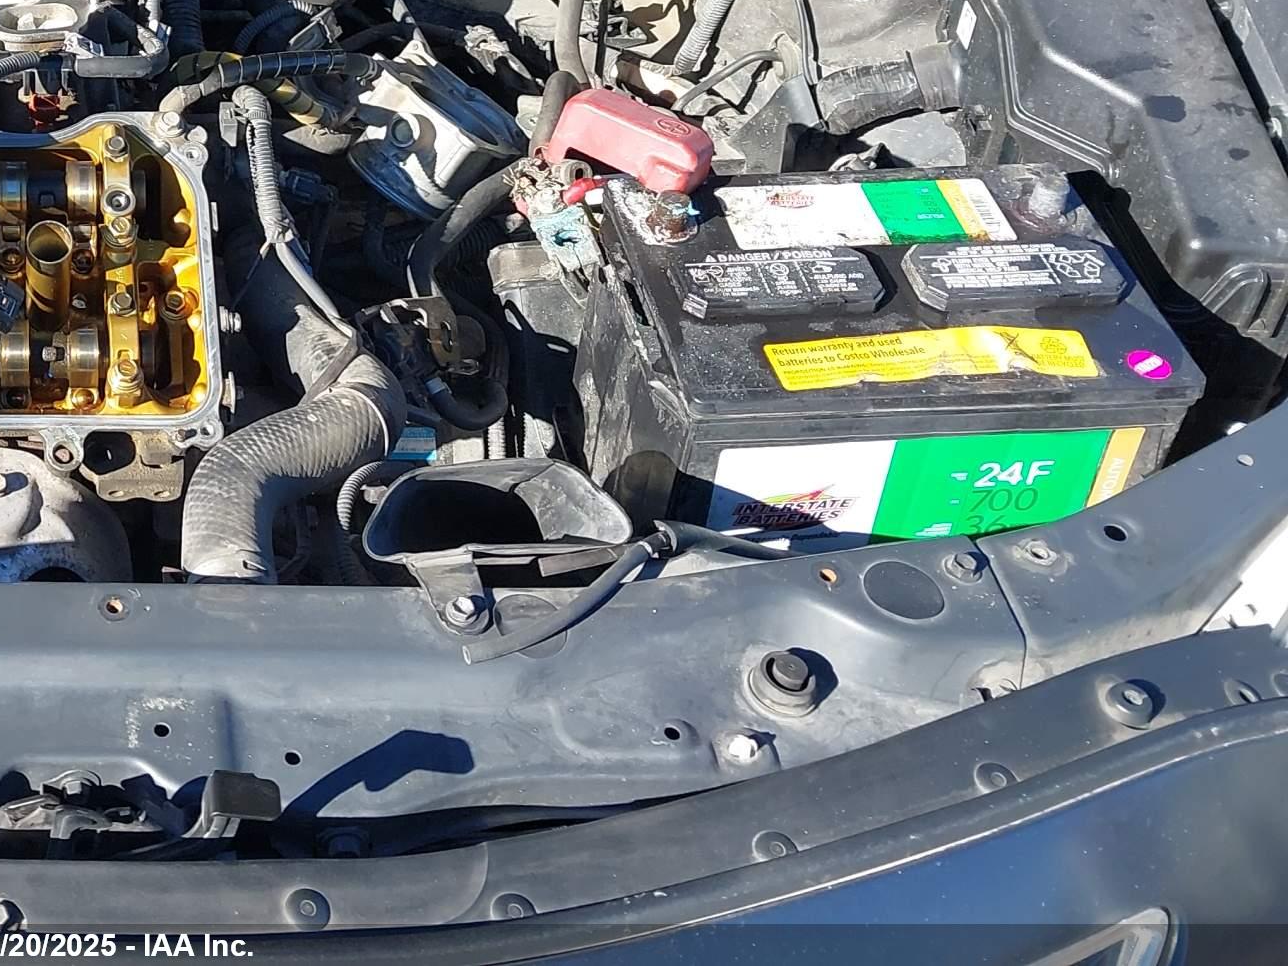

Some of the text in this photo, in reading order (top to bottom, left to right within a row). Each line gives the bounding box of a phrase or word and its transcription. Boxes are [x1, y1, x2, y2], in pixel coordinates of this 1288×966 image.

[717, 251, 770, 263] DANGER
[783, 249, 834, 260] POISON
[771, 336, 903, 357] Return warranty and used
[778, 355, 824, 368] batteries
[825, 355, 837, 364] to
[837, 351, 871, 363] Costco
[871, 345, 927, 360] Wholesale
[973, 460, 1056, 488] 24F
[734, 498, 854, 516] INTERSTATE
[970, 487, 1039, 513] 700
[733, 509, 843, 526] BATTERIES
